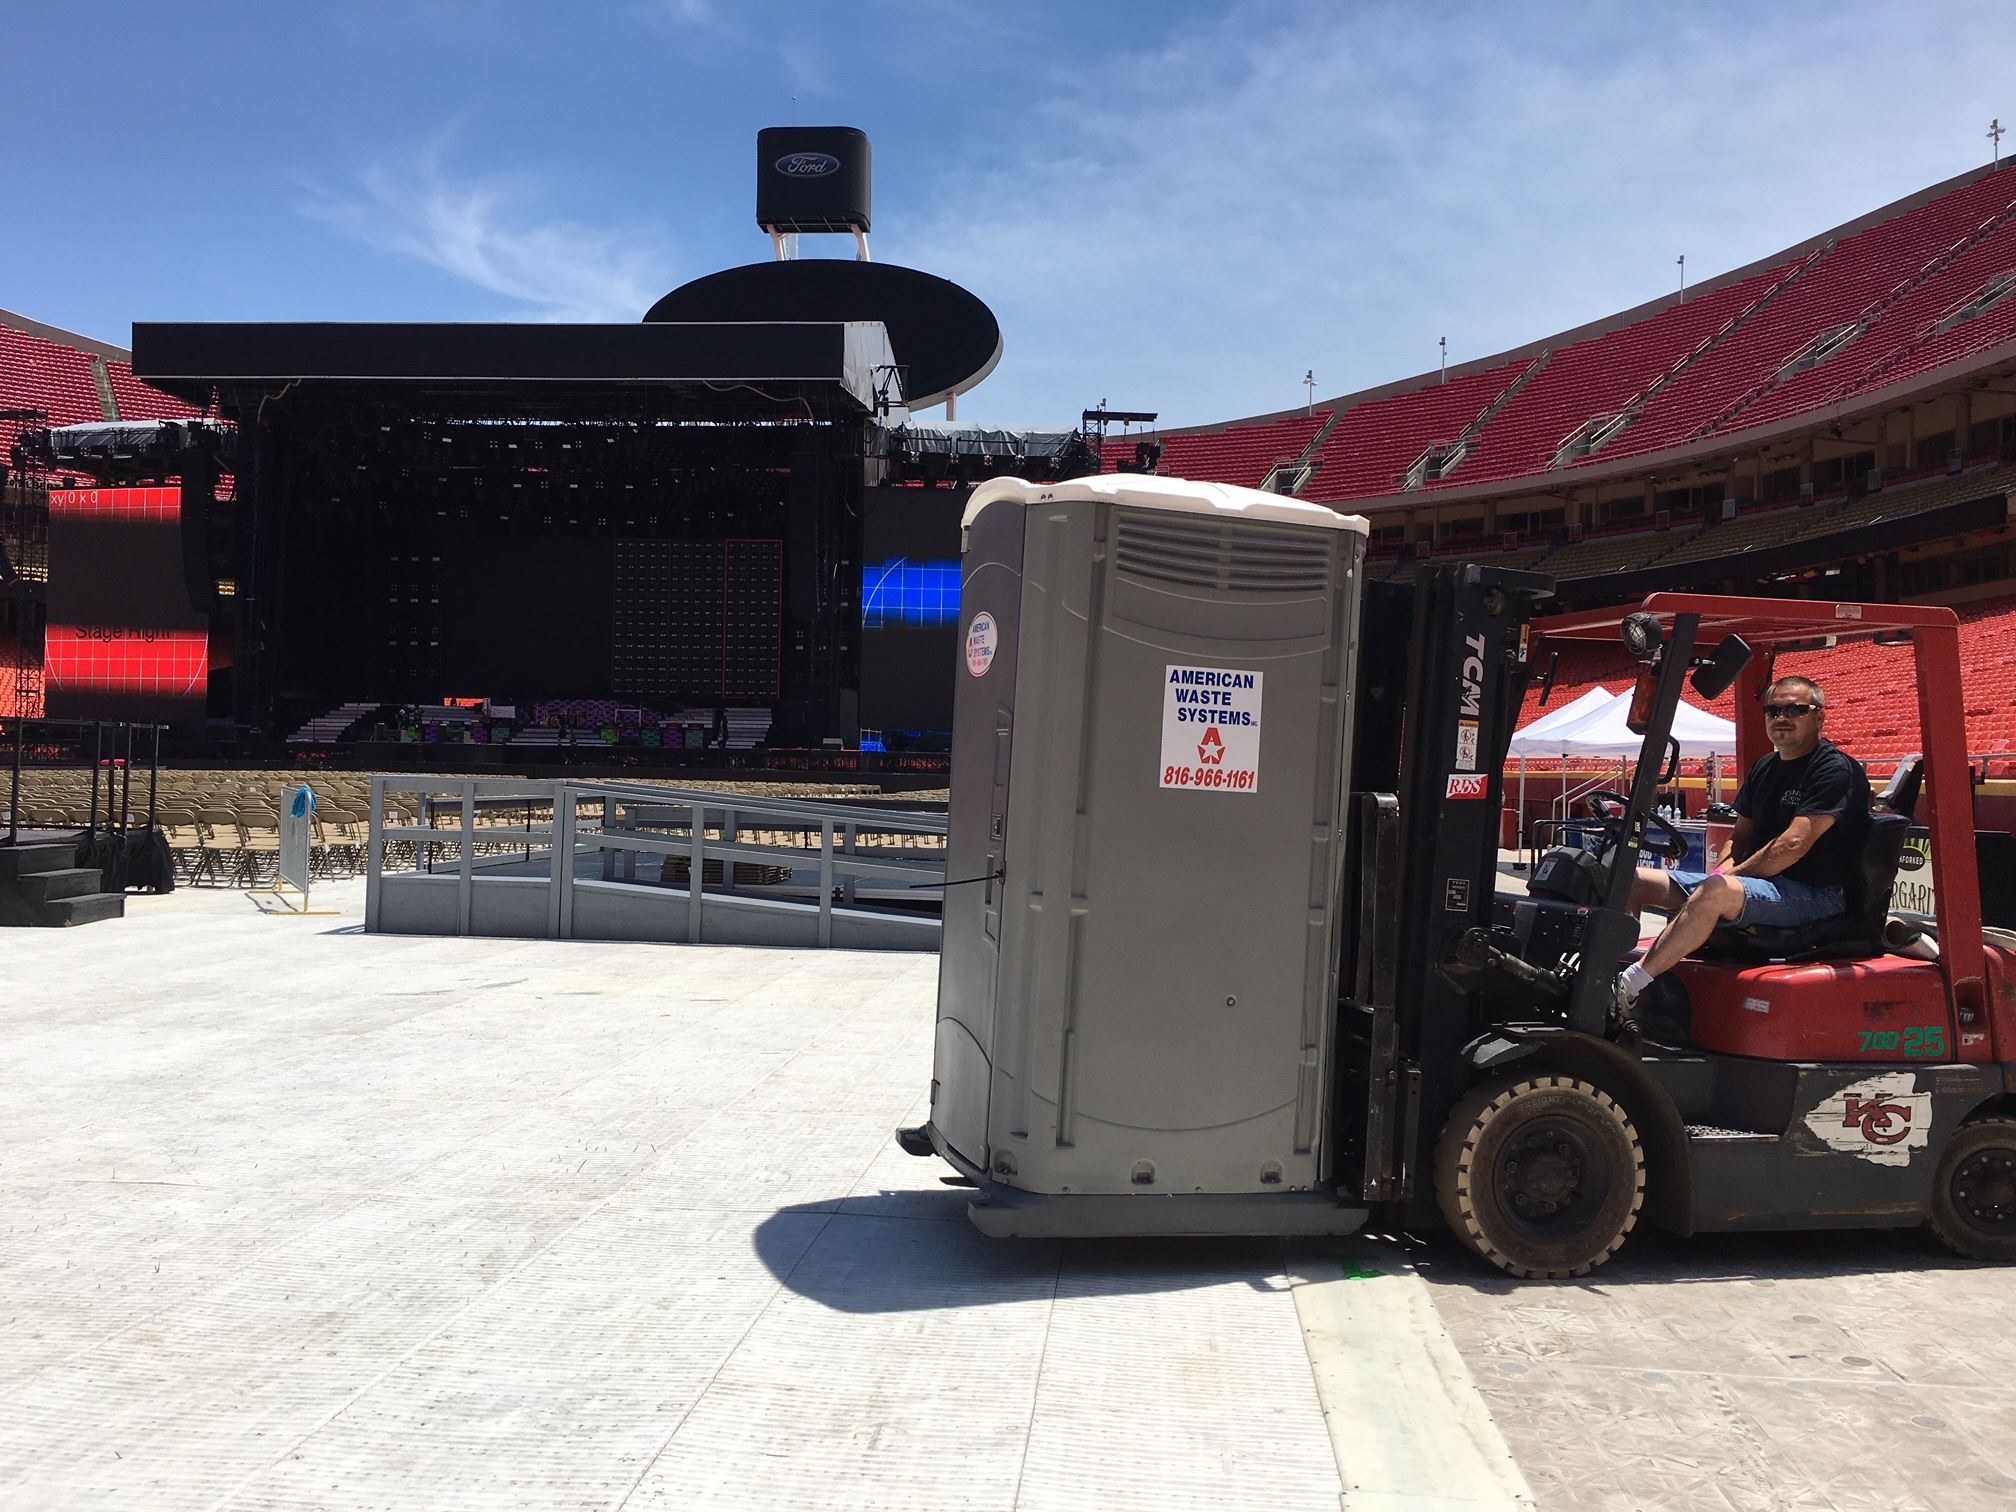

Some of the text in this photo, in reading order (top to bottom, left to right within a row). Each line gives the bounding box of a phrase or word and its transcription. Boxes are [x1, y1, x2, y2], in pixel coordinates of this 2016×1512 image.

[788, 156, 828, 173] Ford
[51, 495, 64, 506] xy
[79, 494, 86, 504] x
[1169, 670, 1254, 689] AMERICAN
[1460, 633, 1486, 716] TCM
[1175, 688, 1232, 706] WASTE
[1177, 708, 1251, 726] SYSTEMS
[1163, 766, 1255, 789] 816-966-1161
[1449, 778, 1482, 795] RDS
[1890, 880, 1935, 915] RGARI
[1903, 1026, 1945, 1057] 25
[1842, 1093, 1911, 1145] KC
